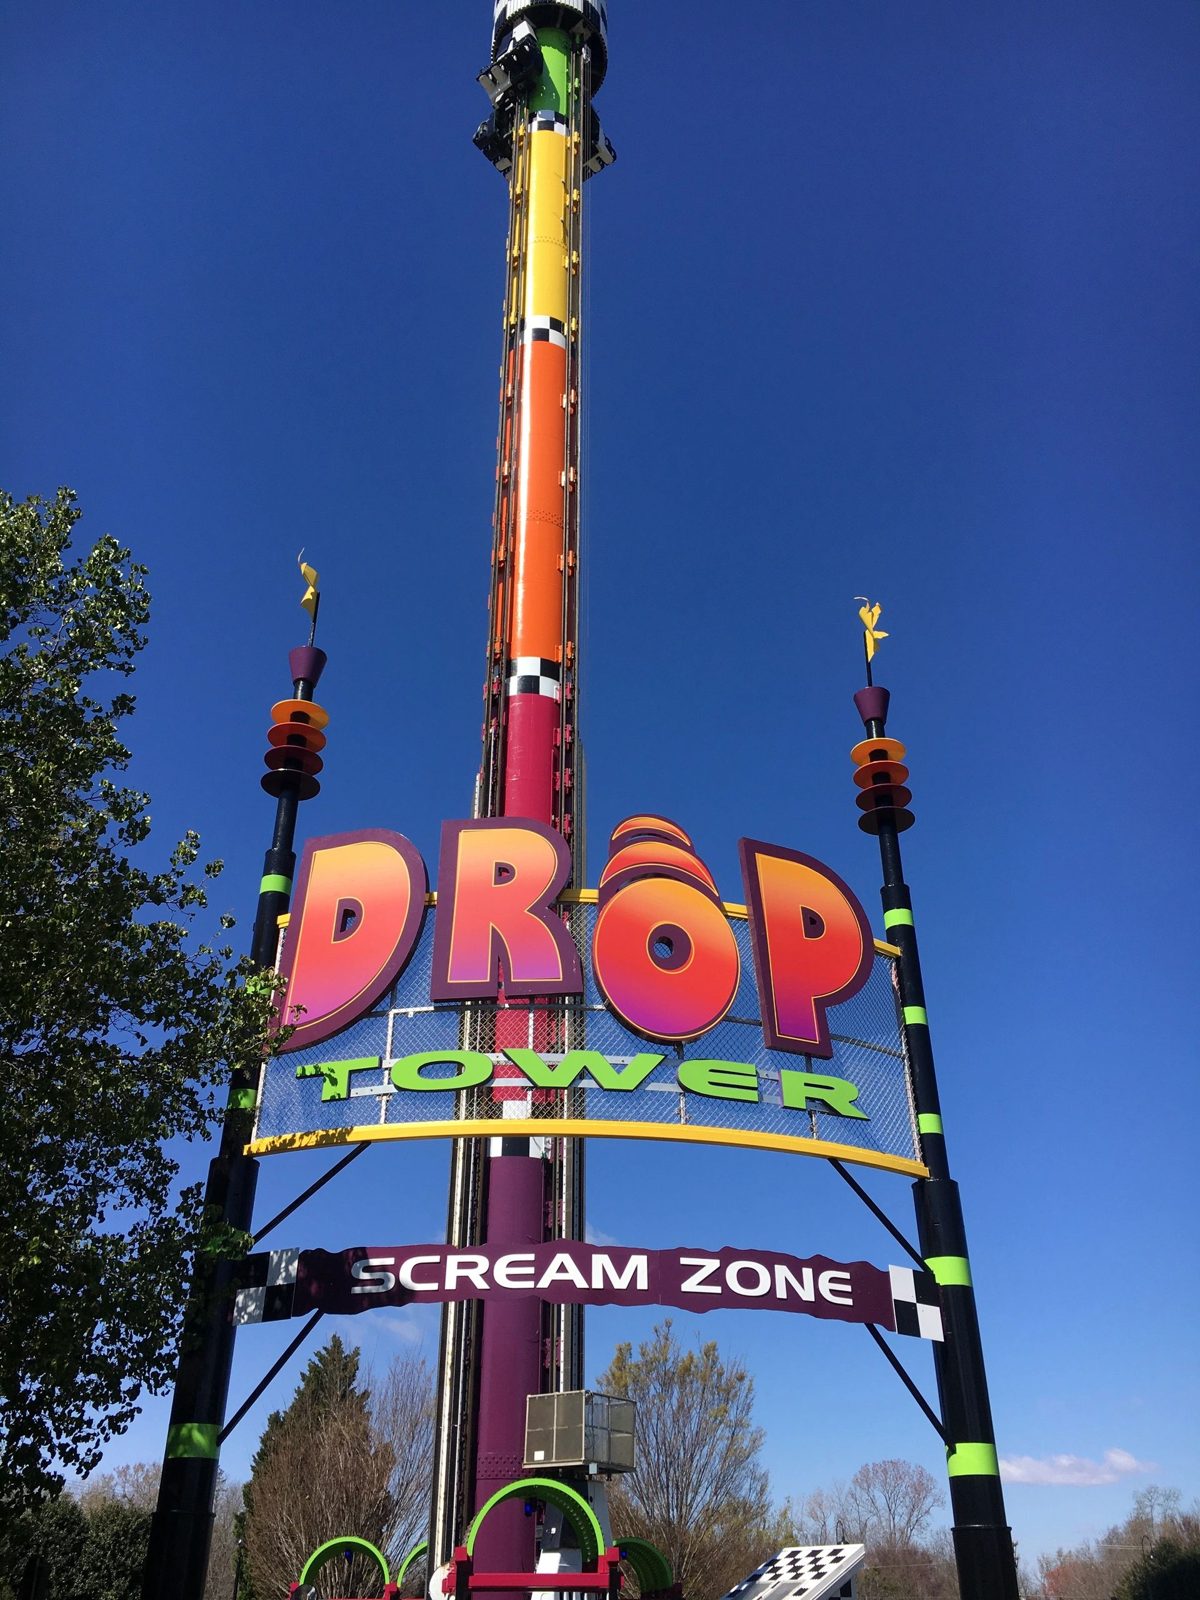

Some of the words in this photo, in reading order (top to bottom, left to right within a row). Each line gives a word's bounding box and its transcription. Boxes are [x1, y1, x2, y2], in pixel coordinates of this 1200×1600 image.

[278, 815, 872, 1057] DROP
[296, 1049, 868, 1120] TOWER
[350, 1253, 649, 1295] SCREAM
[679, 1256, 854, 1307] ZONE
